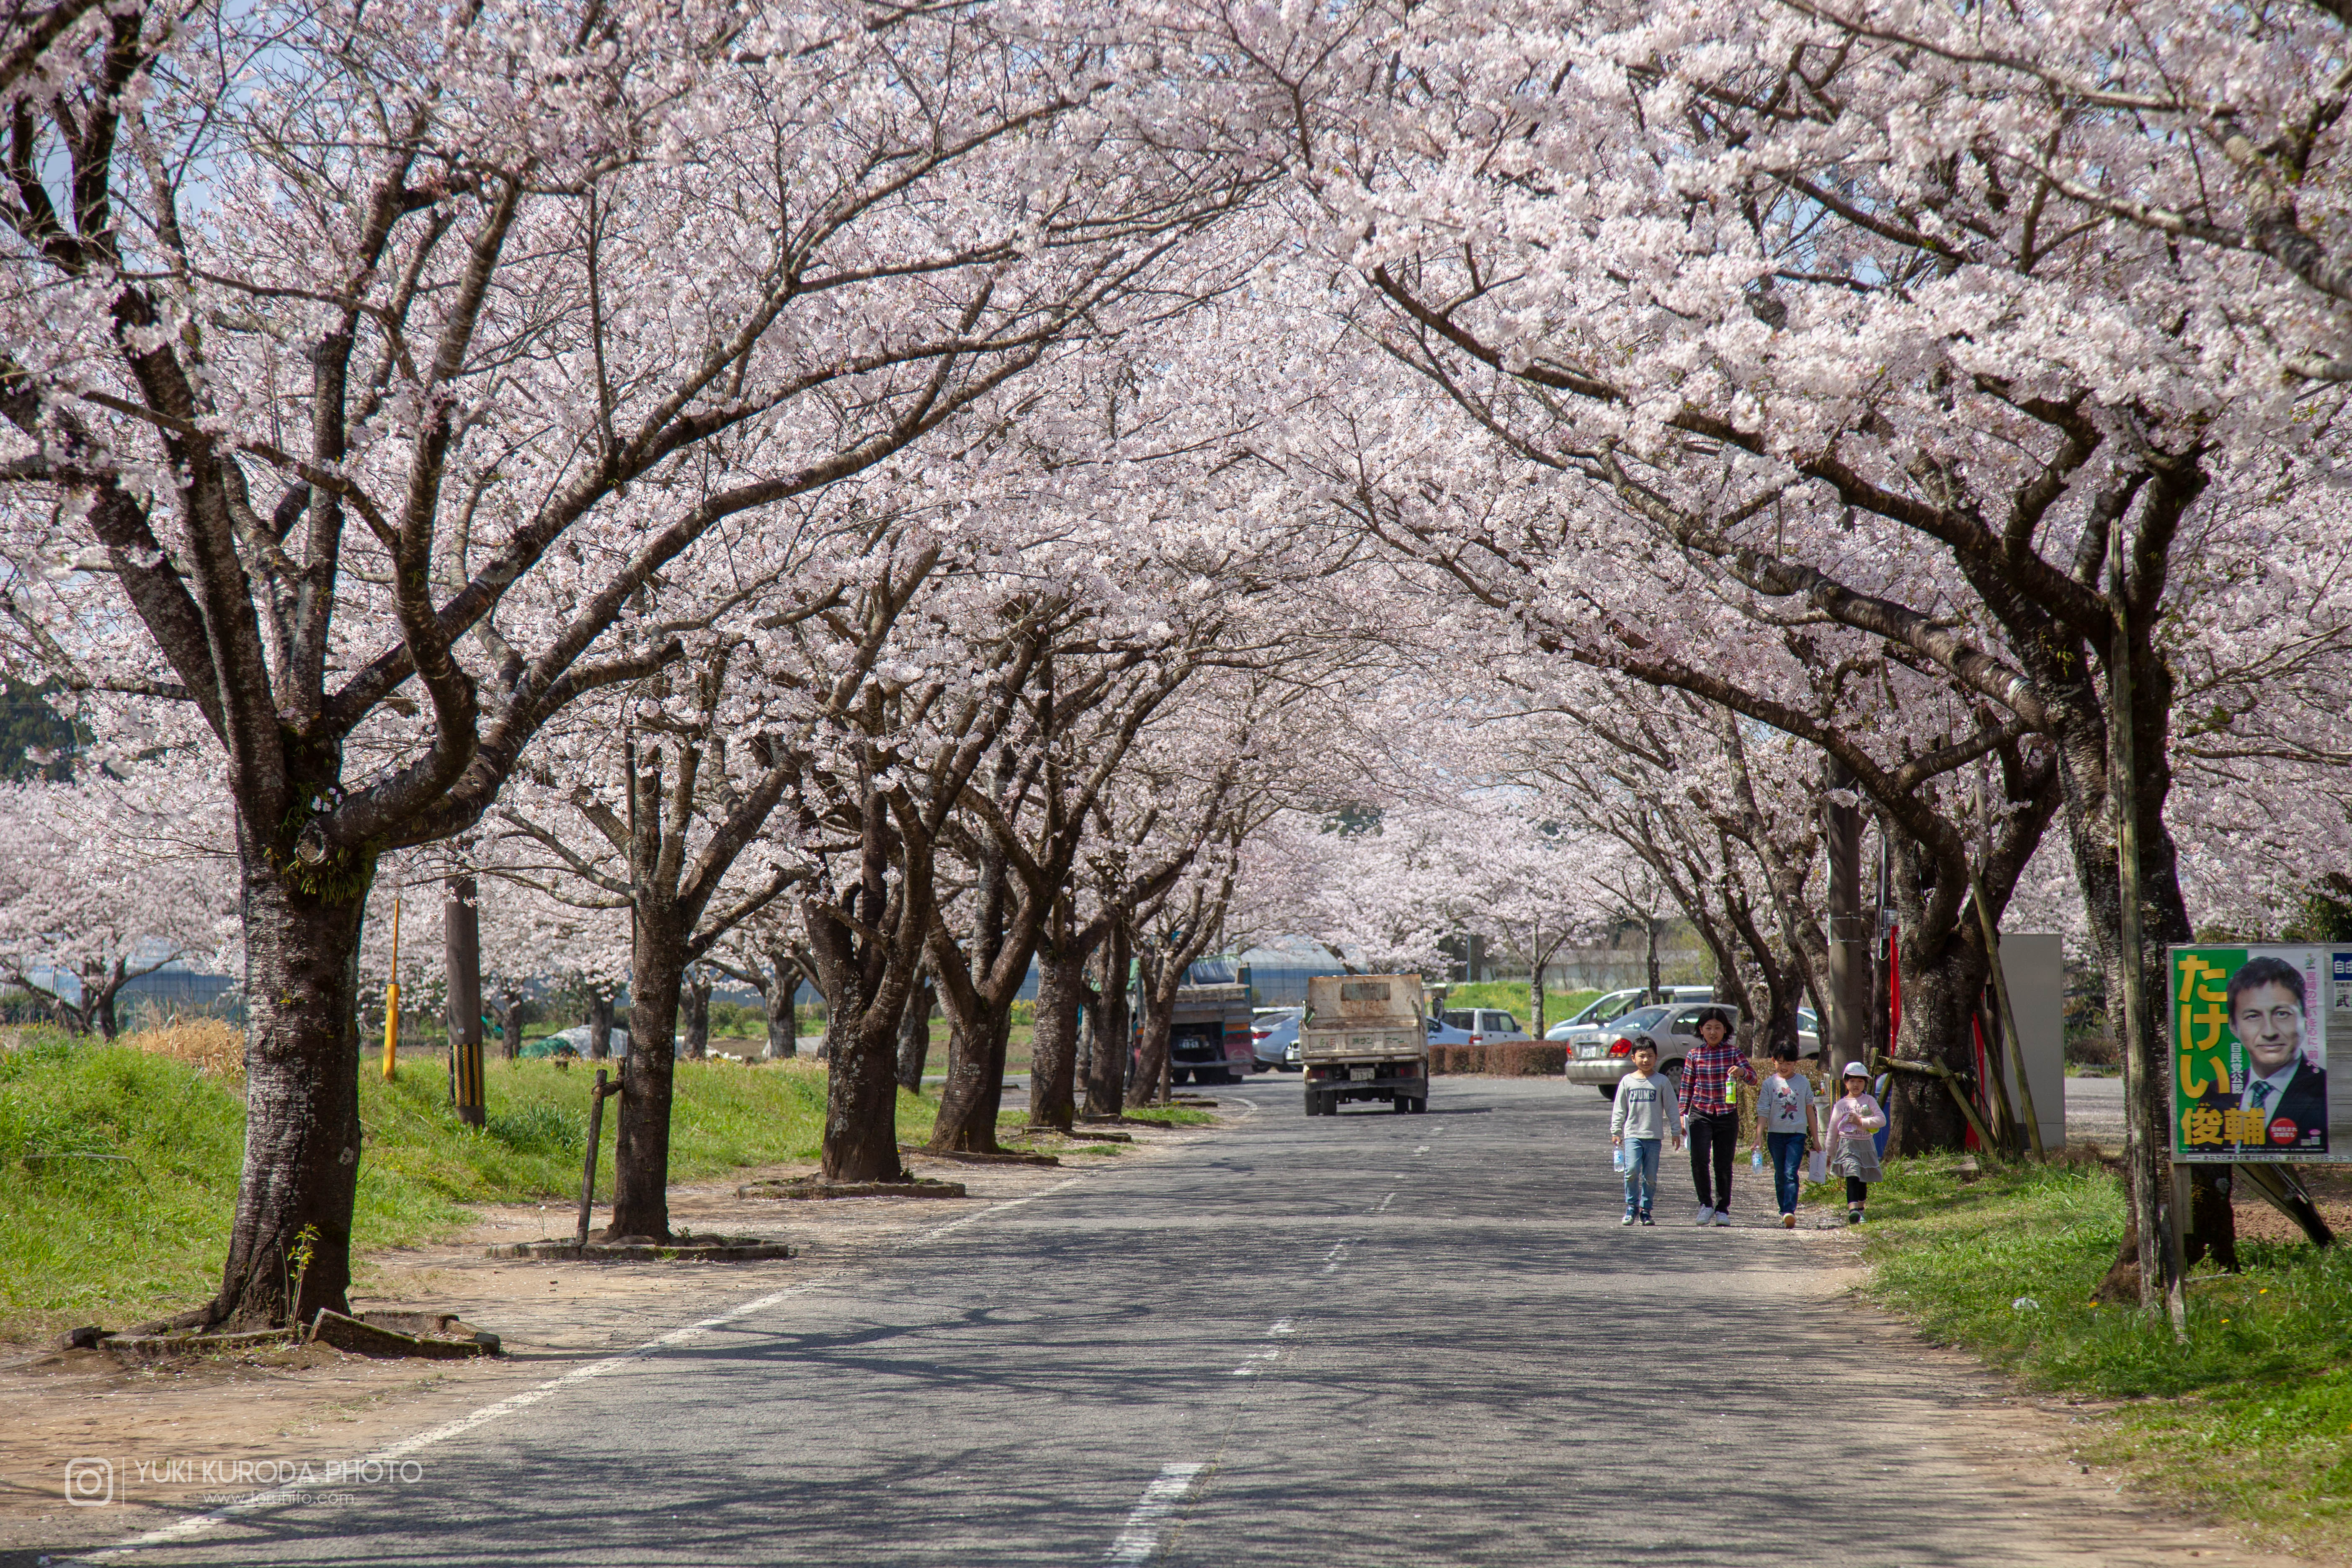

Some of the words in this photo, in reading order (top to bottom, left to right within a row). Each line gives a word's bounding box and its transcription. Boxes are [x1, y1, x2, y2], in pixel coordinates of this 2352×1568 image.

[2336, 994, 2352, 1008] 武
[2178, 955, 2231, 1099] たけい
[2231, 1042, 2244, 1094] 自民党公認
[1630, 1090, 1655, 1100] CHUMS
[2180, 1108, 2265, 1145] 俊輔
